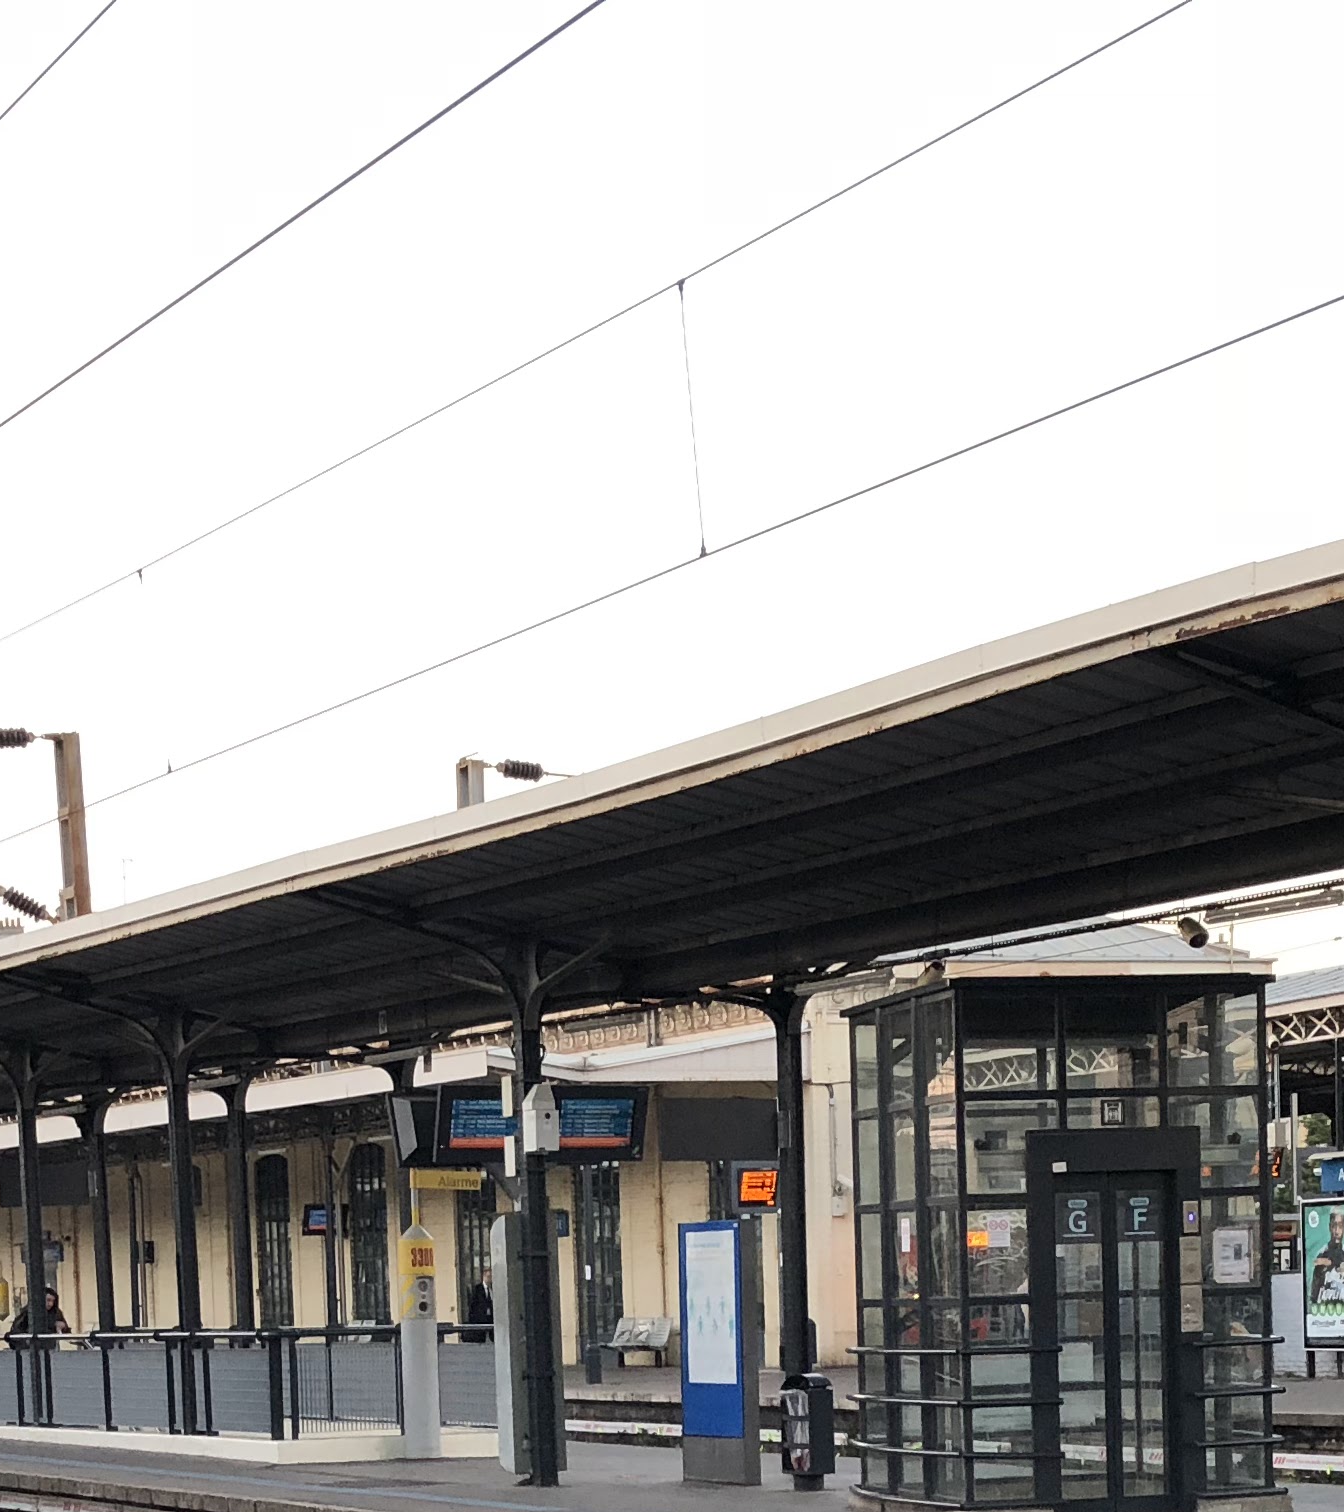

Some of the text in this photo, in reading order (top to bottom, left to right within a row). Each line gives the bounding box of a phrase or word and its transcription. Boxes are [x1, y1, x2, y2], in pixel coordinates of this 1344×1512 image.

[437, 1175, 479, 1188] Alarme
[1068, 1210, 1087, 1233] G
[1133, 1207, 1148, 1231] F
